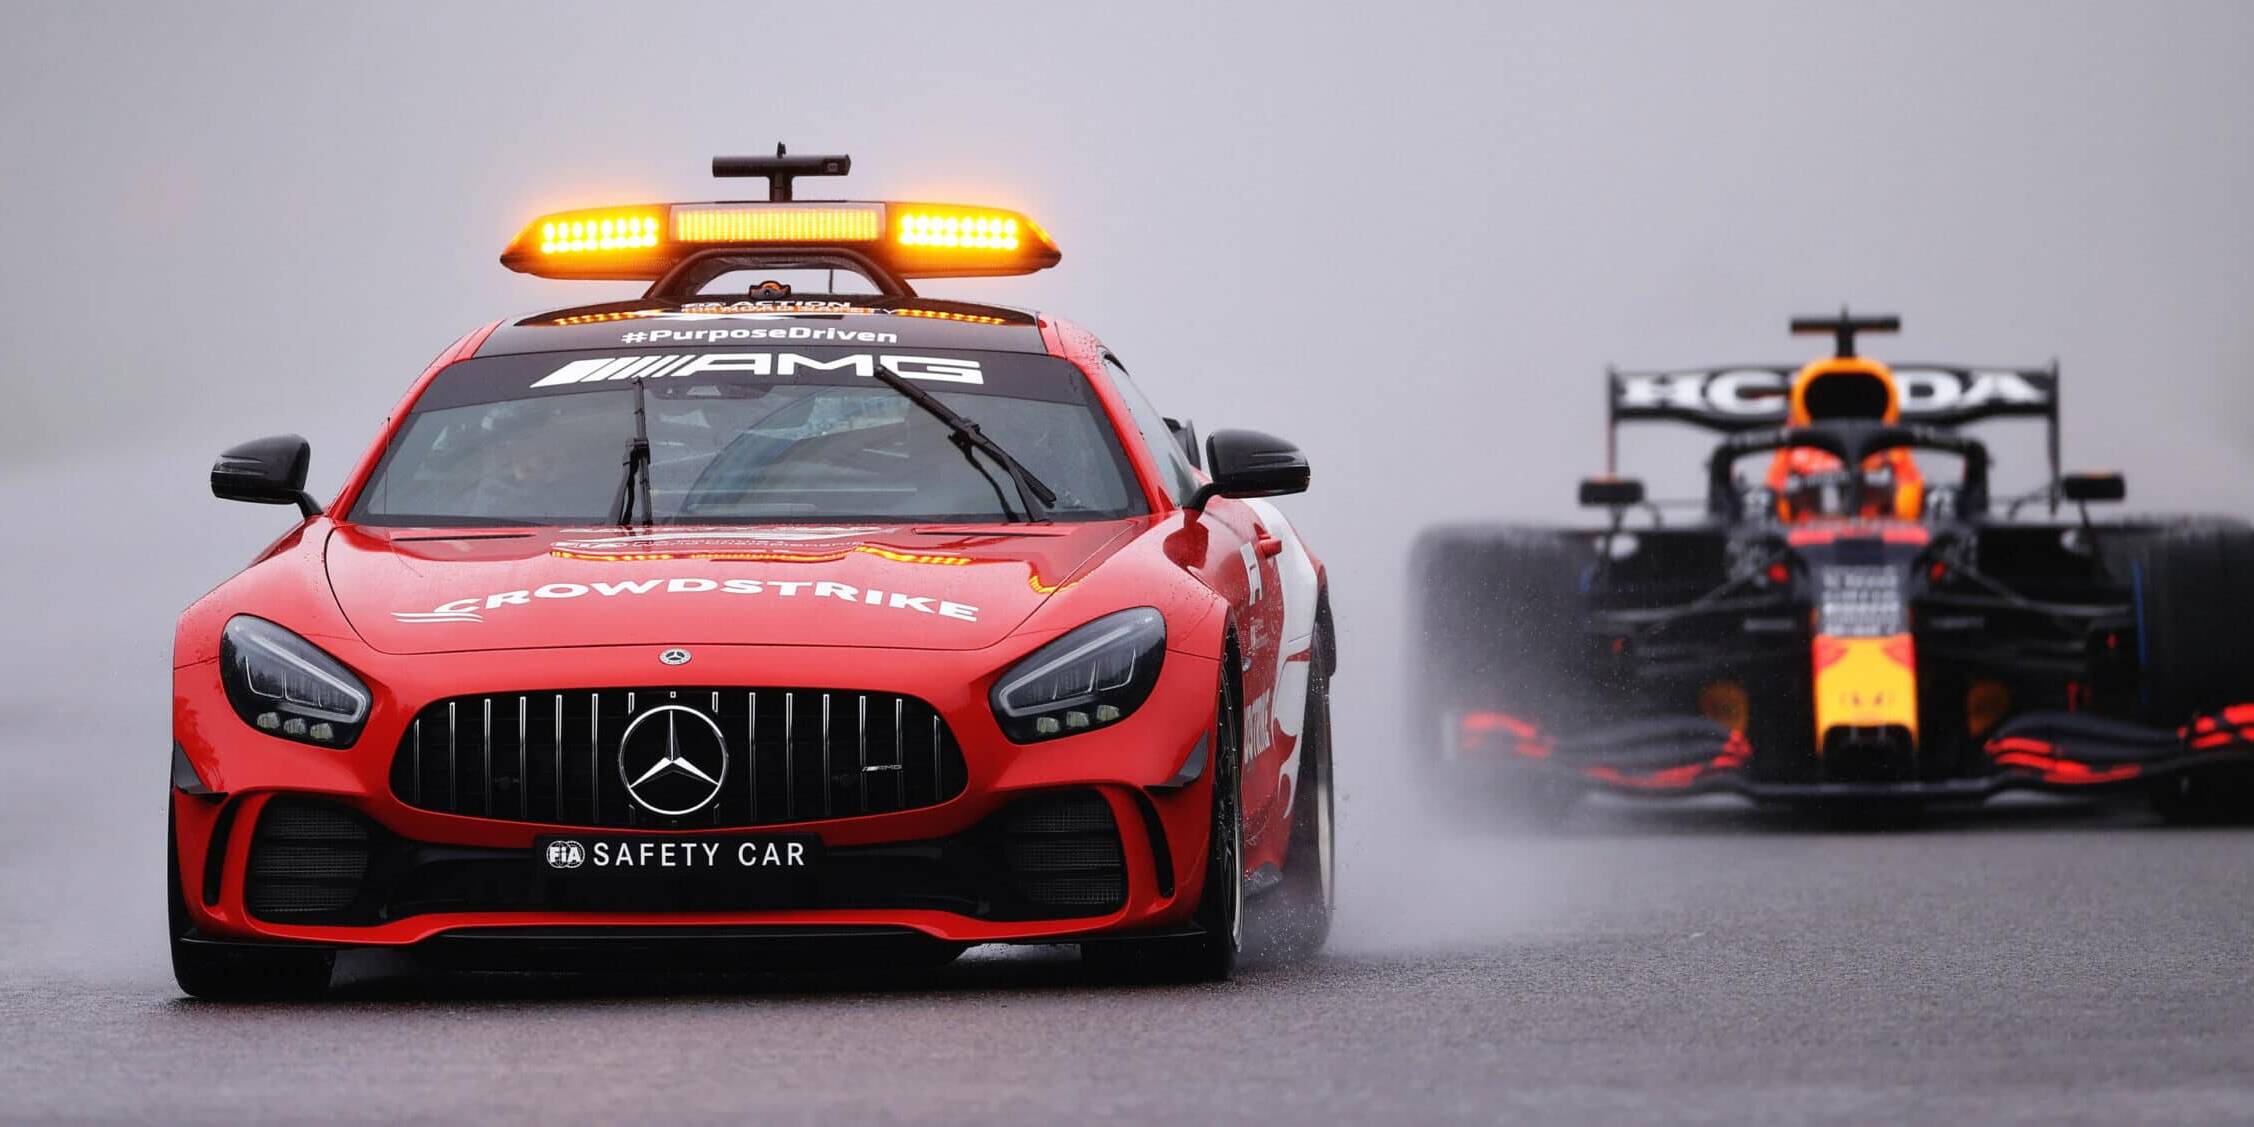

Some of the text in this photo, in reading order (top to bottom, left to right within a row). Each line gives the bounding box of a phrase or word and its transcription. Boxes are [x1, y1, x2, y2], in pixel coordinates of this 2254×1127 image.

[621, 326, 898, 344] #PurposeDriven
[433, 578, 980, 622] CROWDSTRIKE
[593, 842, 720, 867] SAFETY
[738, 842, 805, 867] CAR
